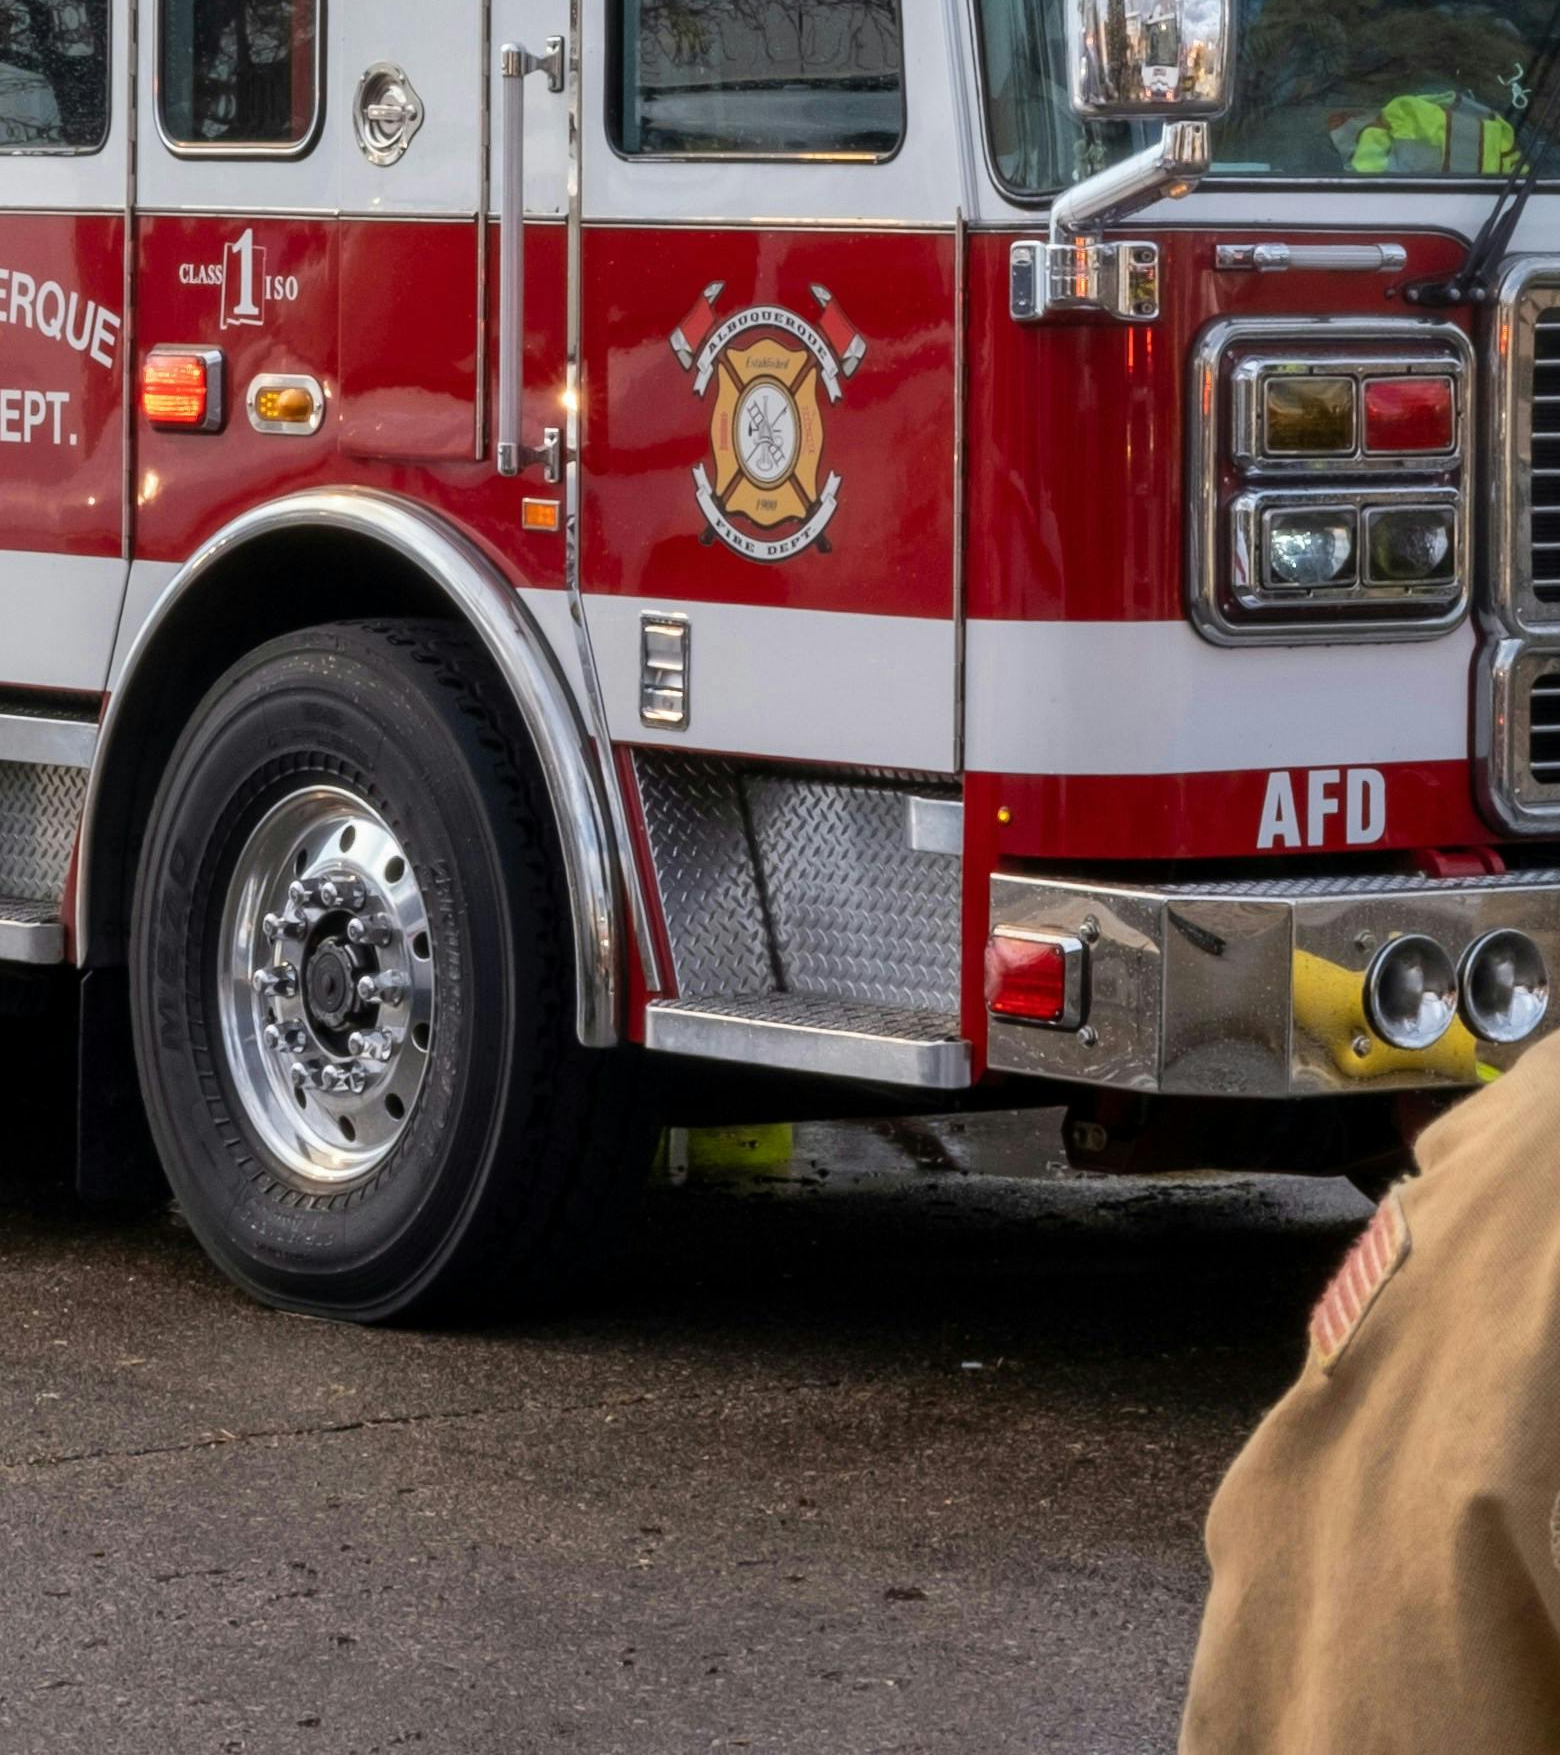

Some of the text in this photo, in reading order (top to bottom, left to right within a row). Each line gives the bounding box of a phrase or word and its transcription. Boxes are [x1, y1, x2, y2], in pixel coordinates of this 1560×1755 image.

[179, 228, 298, 315] CLASS 1 ISO
[707, 311, 828, 361] ALBUQUERQUE
[715, 518, 756, 554] FIRE
[1256, 767, 1386, 850] AFD
